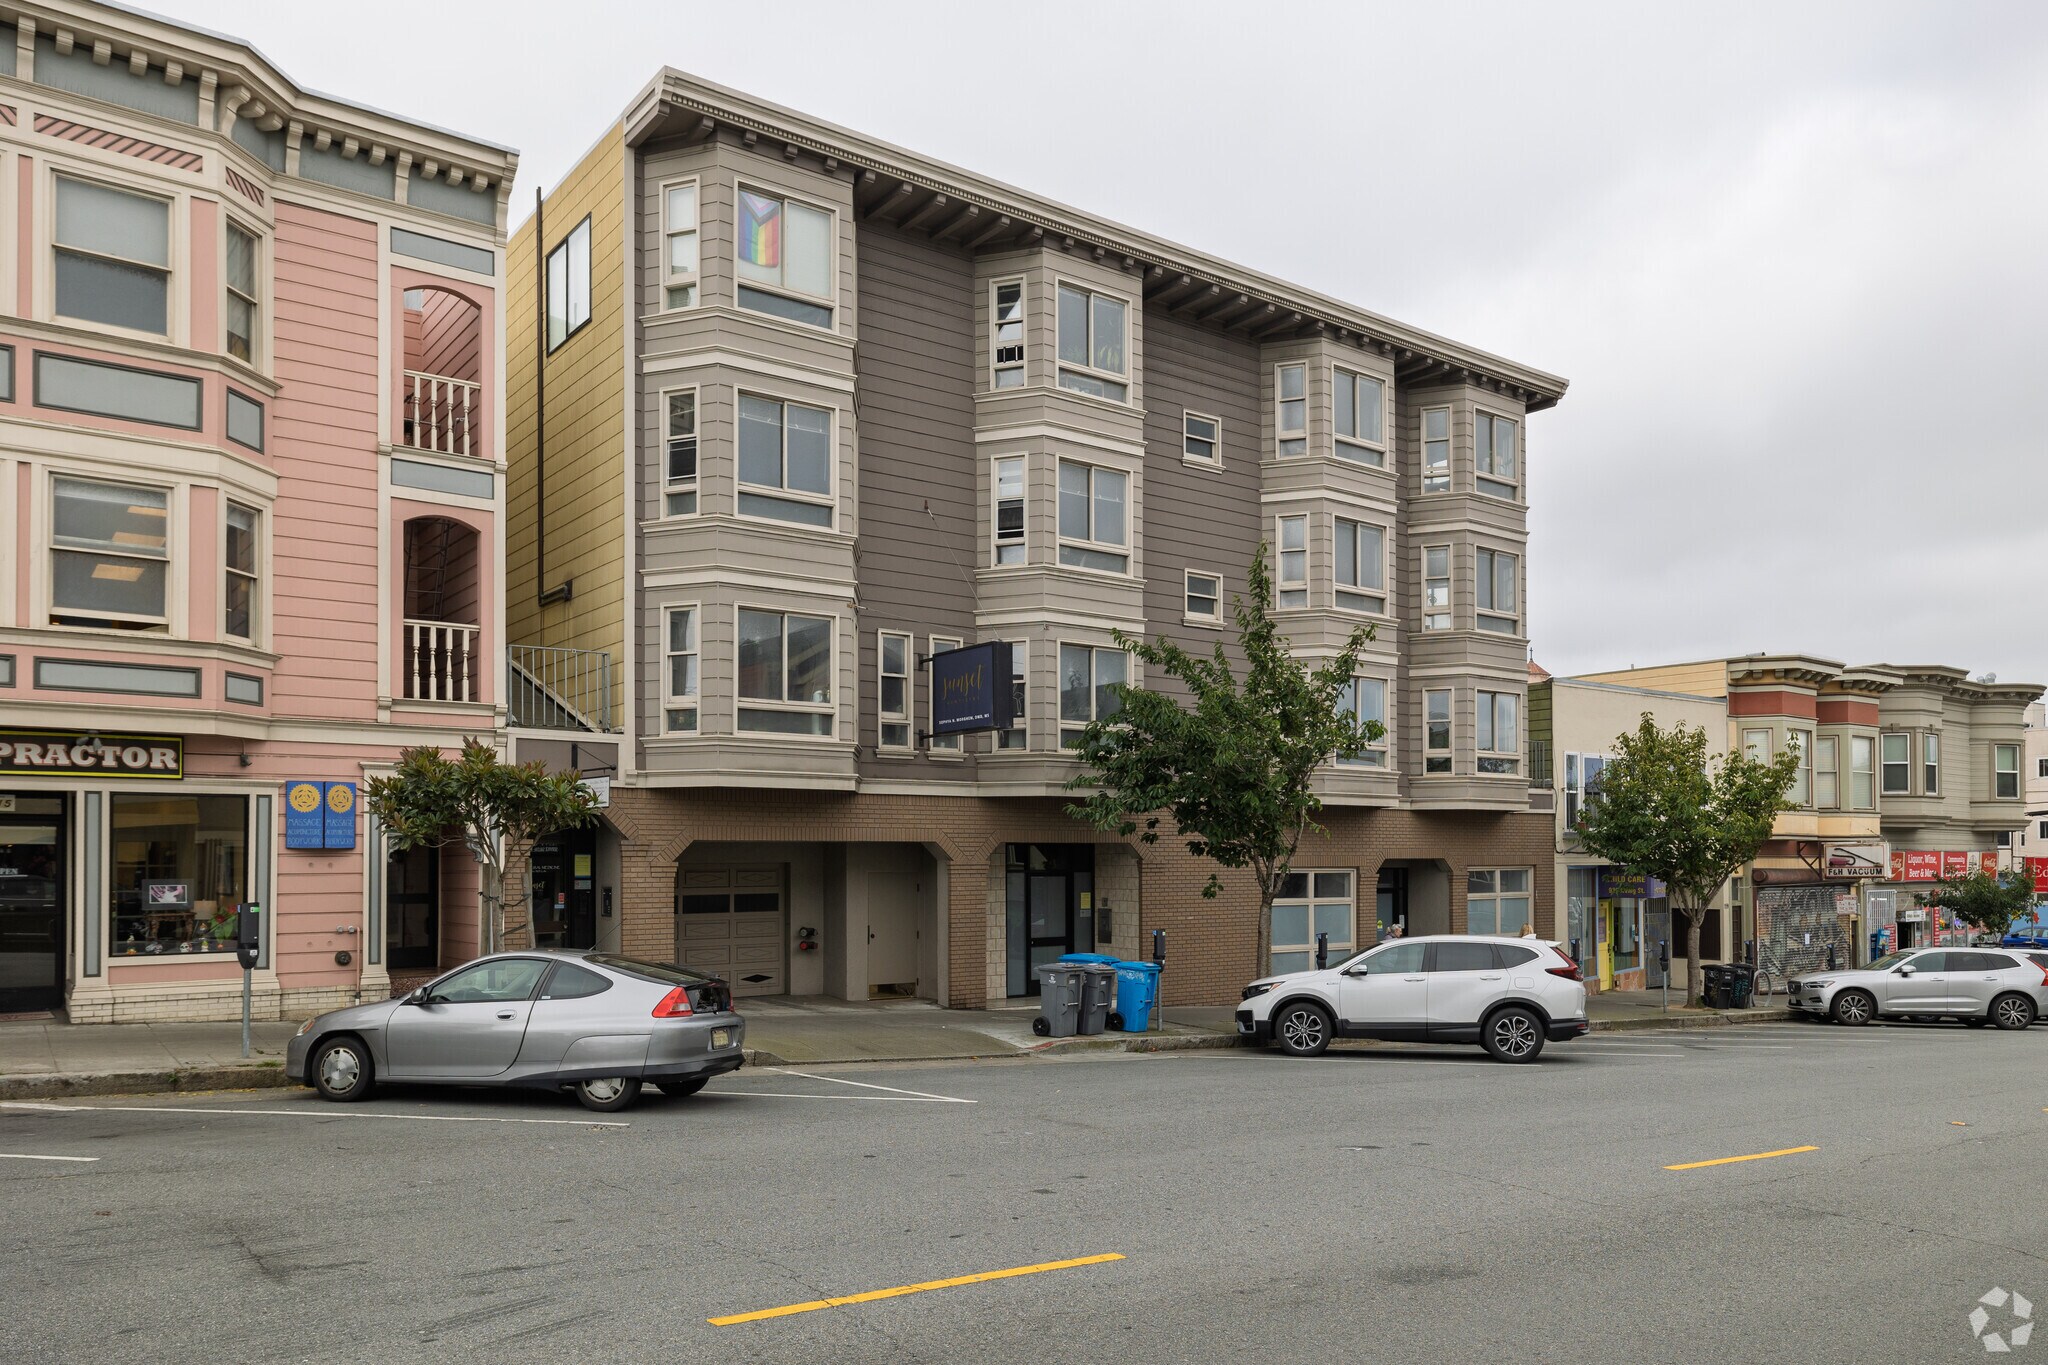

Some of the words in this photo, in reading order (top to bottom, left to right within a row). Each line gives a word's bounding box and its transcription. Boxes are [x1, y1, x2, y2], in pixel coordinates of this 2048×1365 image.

[0, 742, 178, 770] PRACTOR
[288, 818, 320, 827] MASSAGE
[326, 818, 353, 827] MASSAGE
[1909, 868, 1920, 878] Beer
[1627, 875, 1645, 883] CARE
